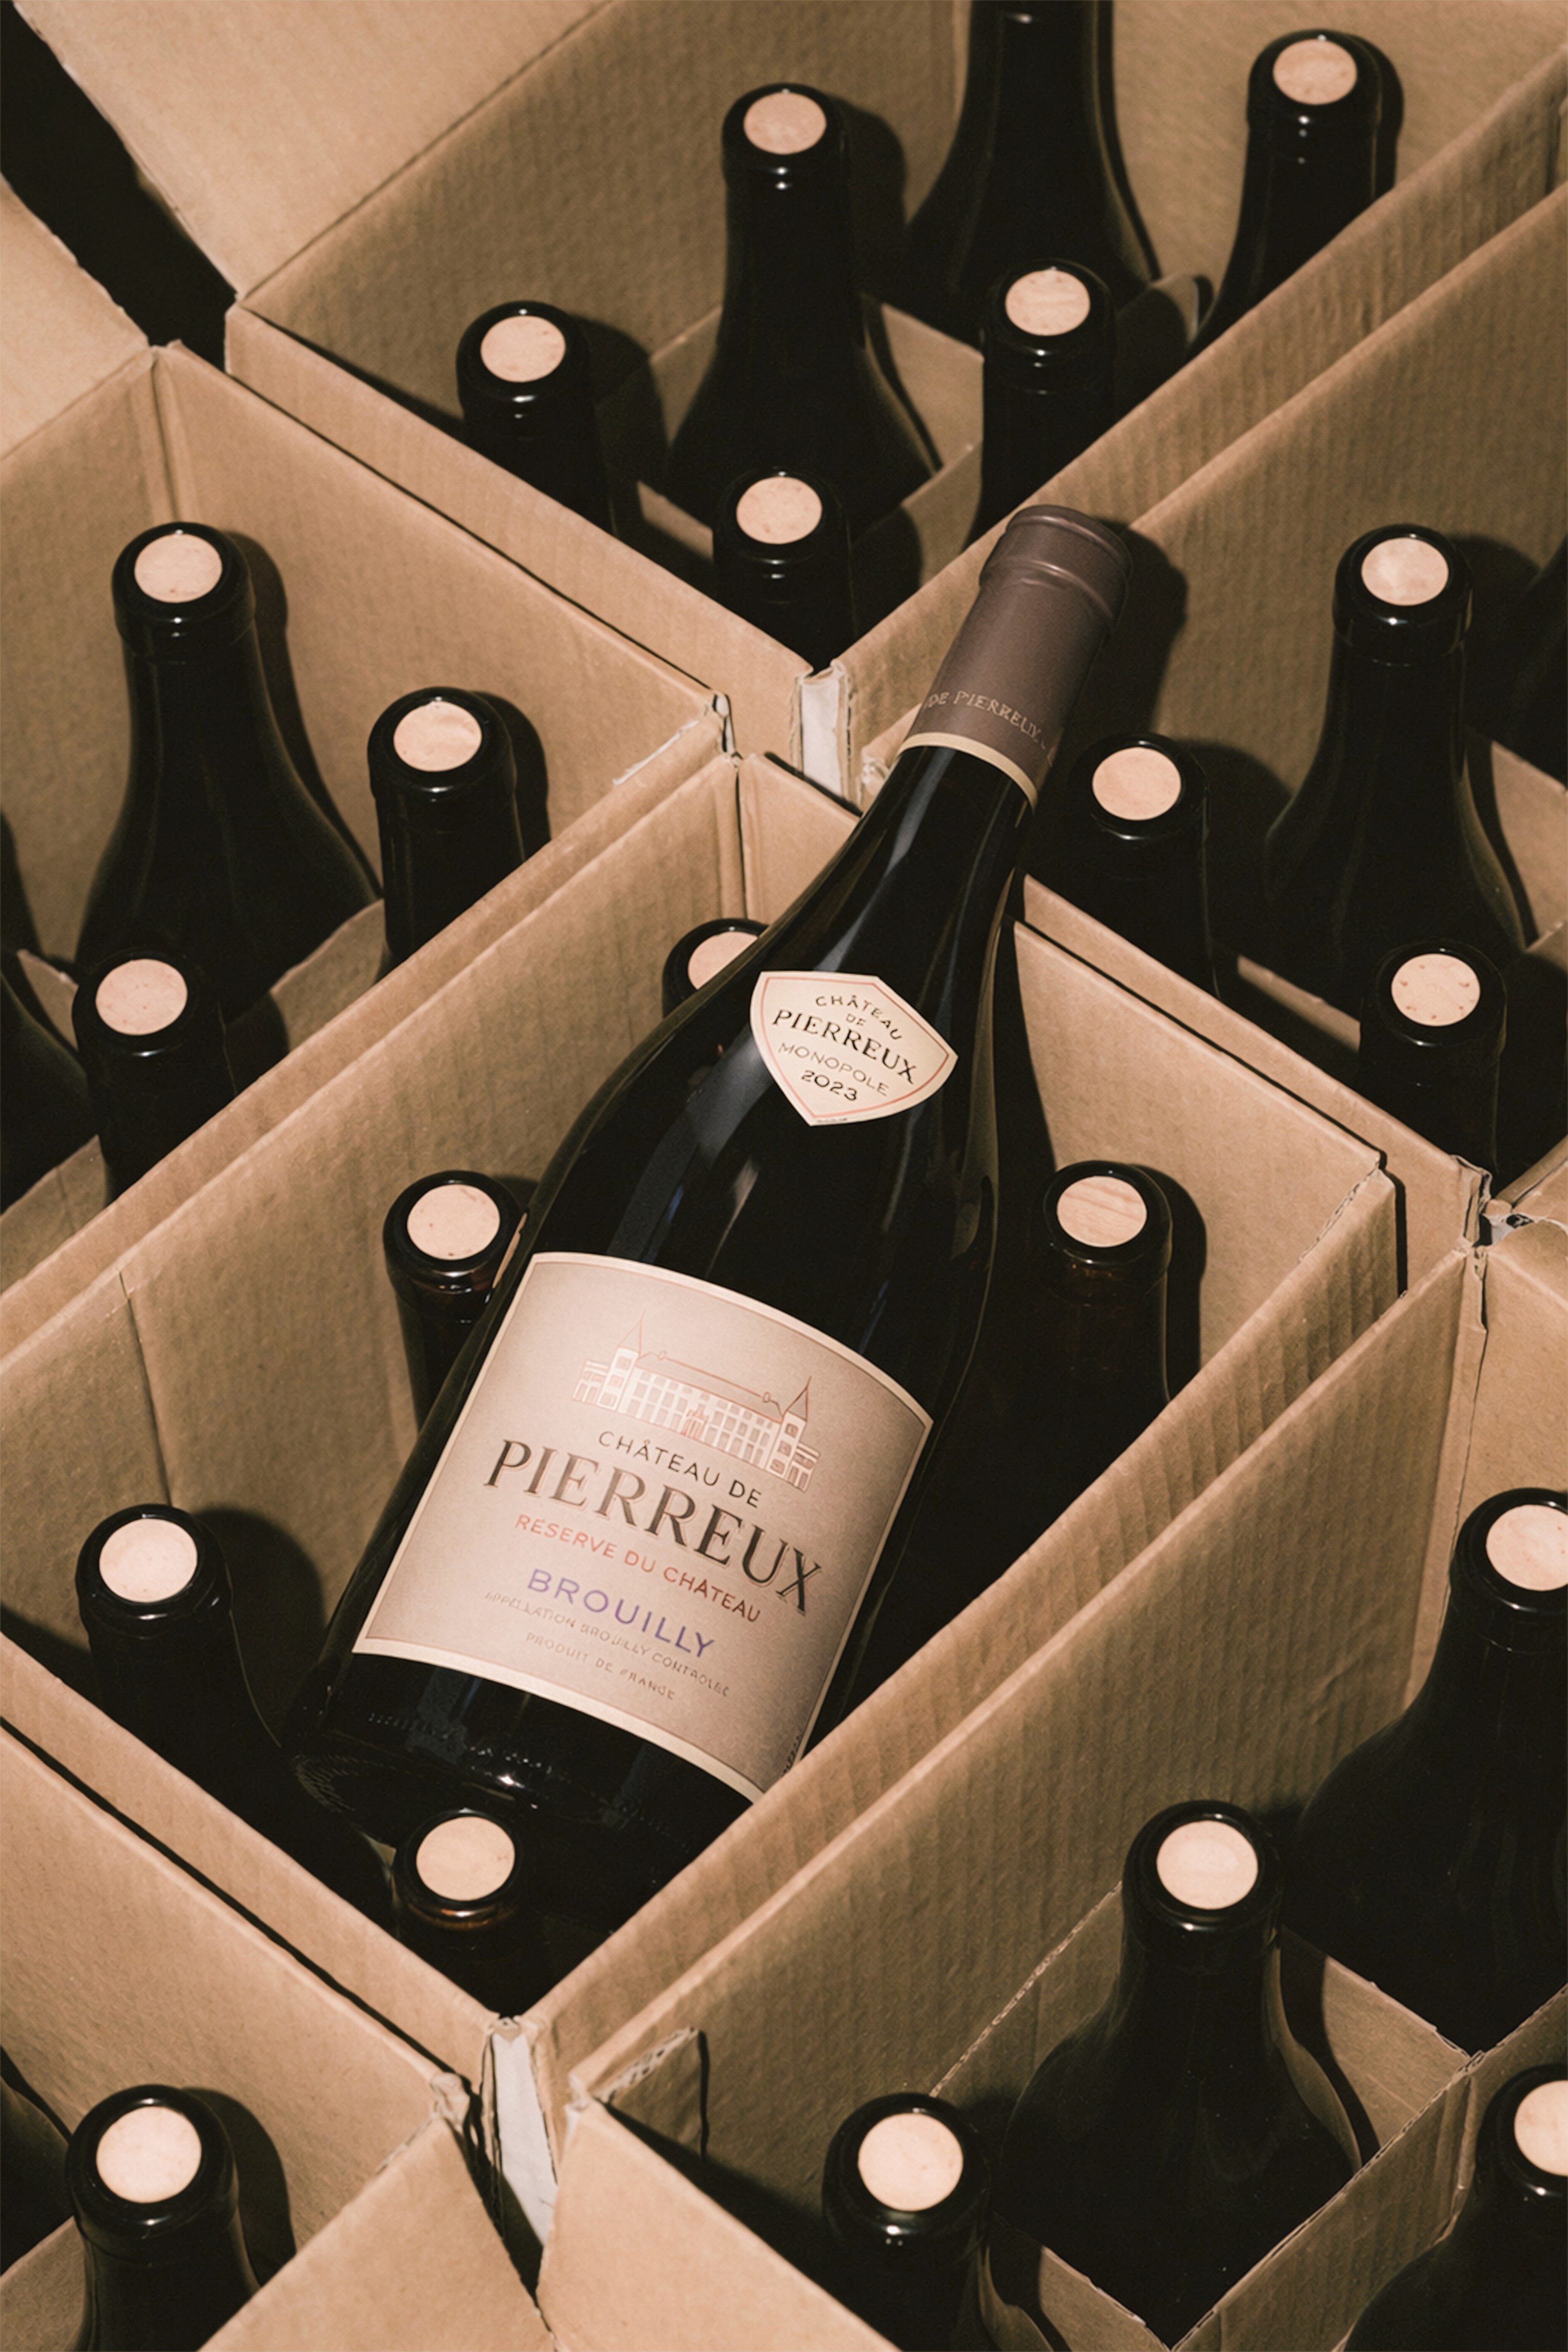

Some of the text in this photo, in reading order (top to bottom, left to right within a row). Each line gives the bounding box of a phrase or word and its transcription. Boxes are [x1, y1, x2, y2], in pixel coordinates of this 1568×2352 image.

[815, 994, 903, 1041] CHÂTEAU
[845, 1013, 867, 1028] DE
[771, 1008, 917, 1085] PIERREUX
[777, 1042, 890, 1097] MONOPOLE
[801, 1069, 859, 1102] 2023
[598, 1430, 762, 1509] CHÂTEAU DE
[483, 1439, 823, 1616] PIERREUX
[623, 1549, 656, 1573] DU
[527, 1568, 716, 1658] BROUILLY
